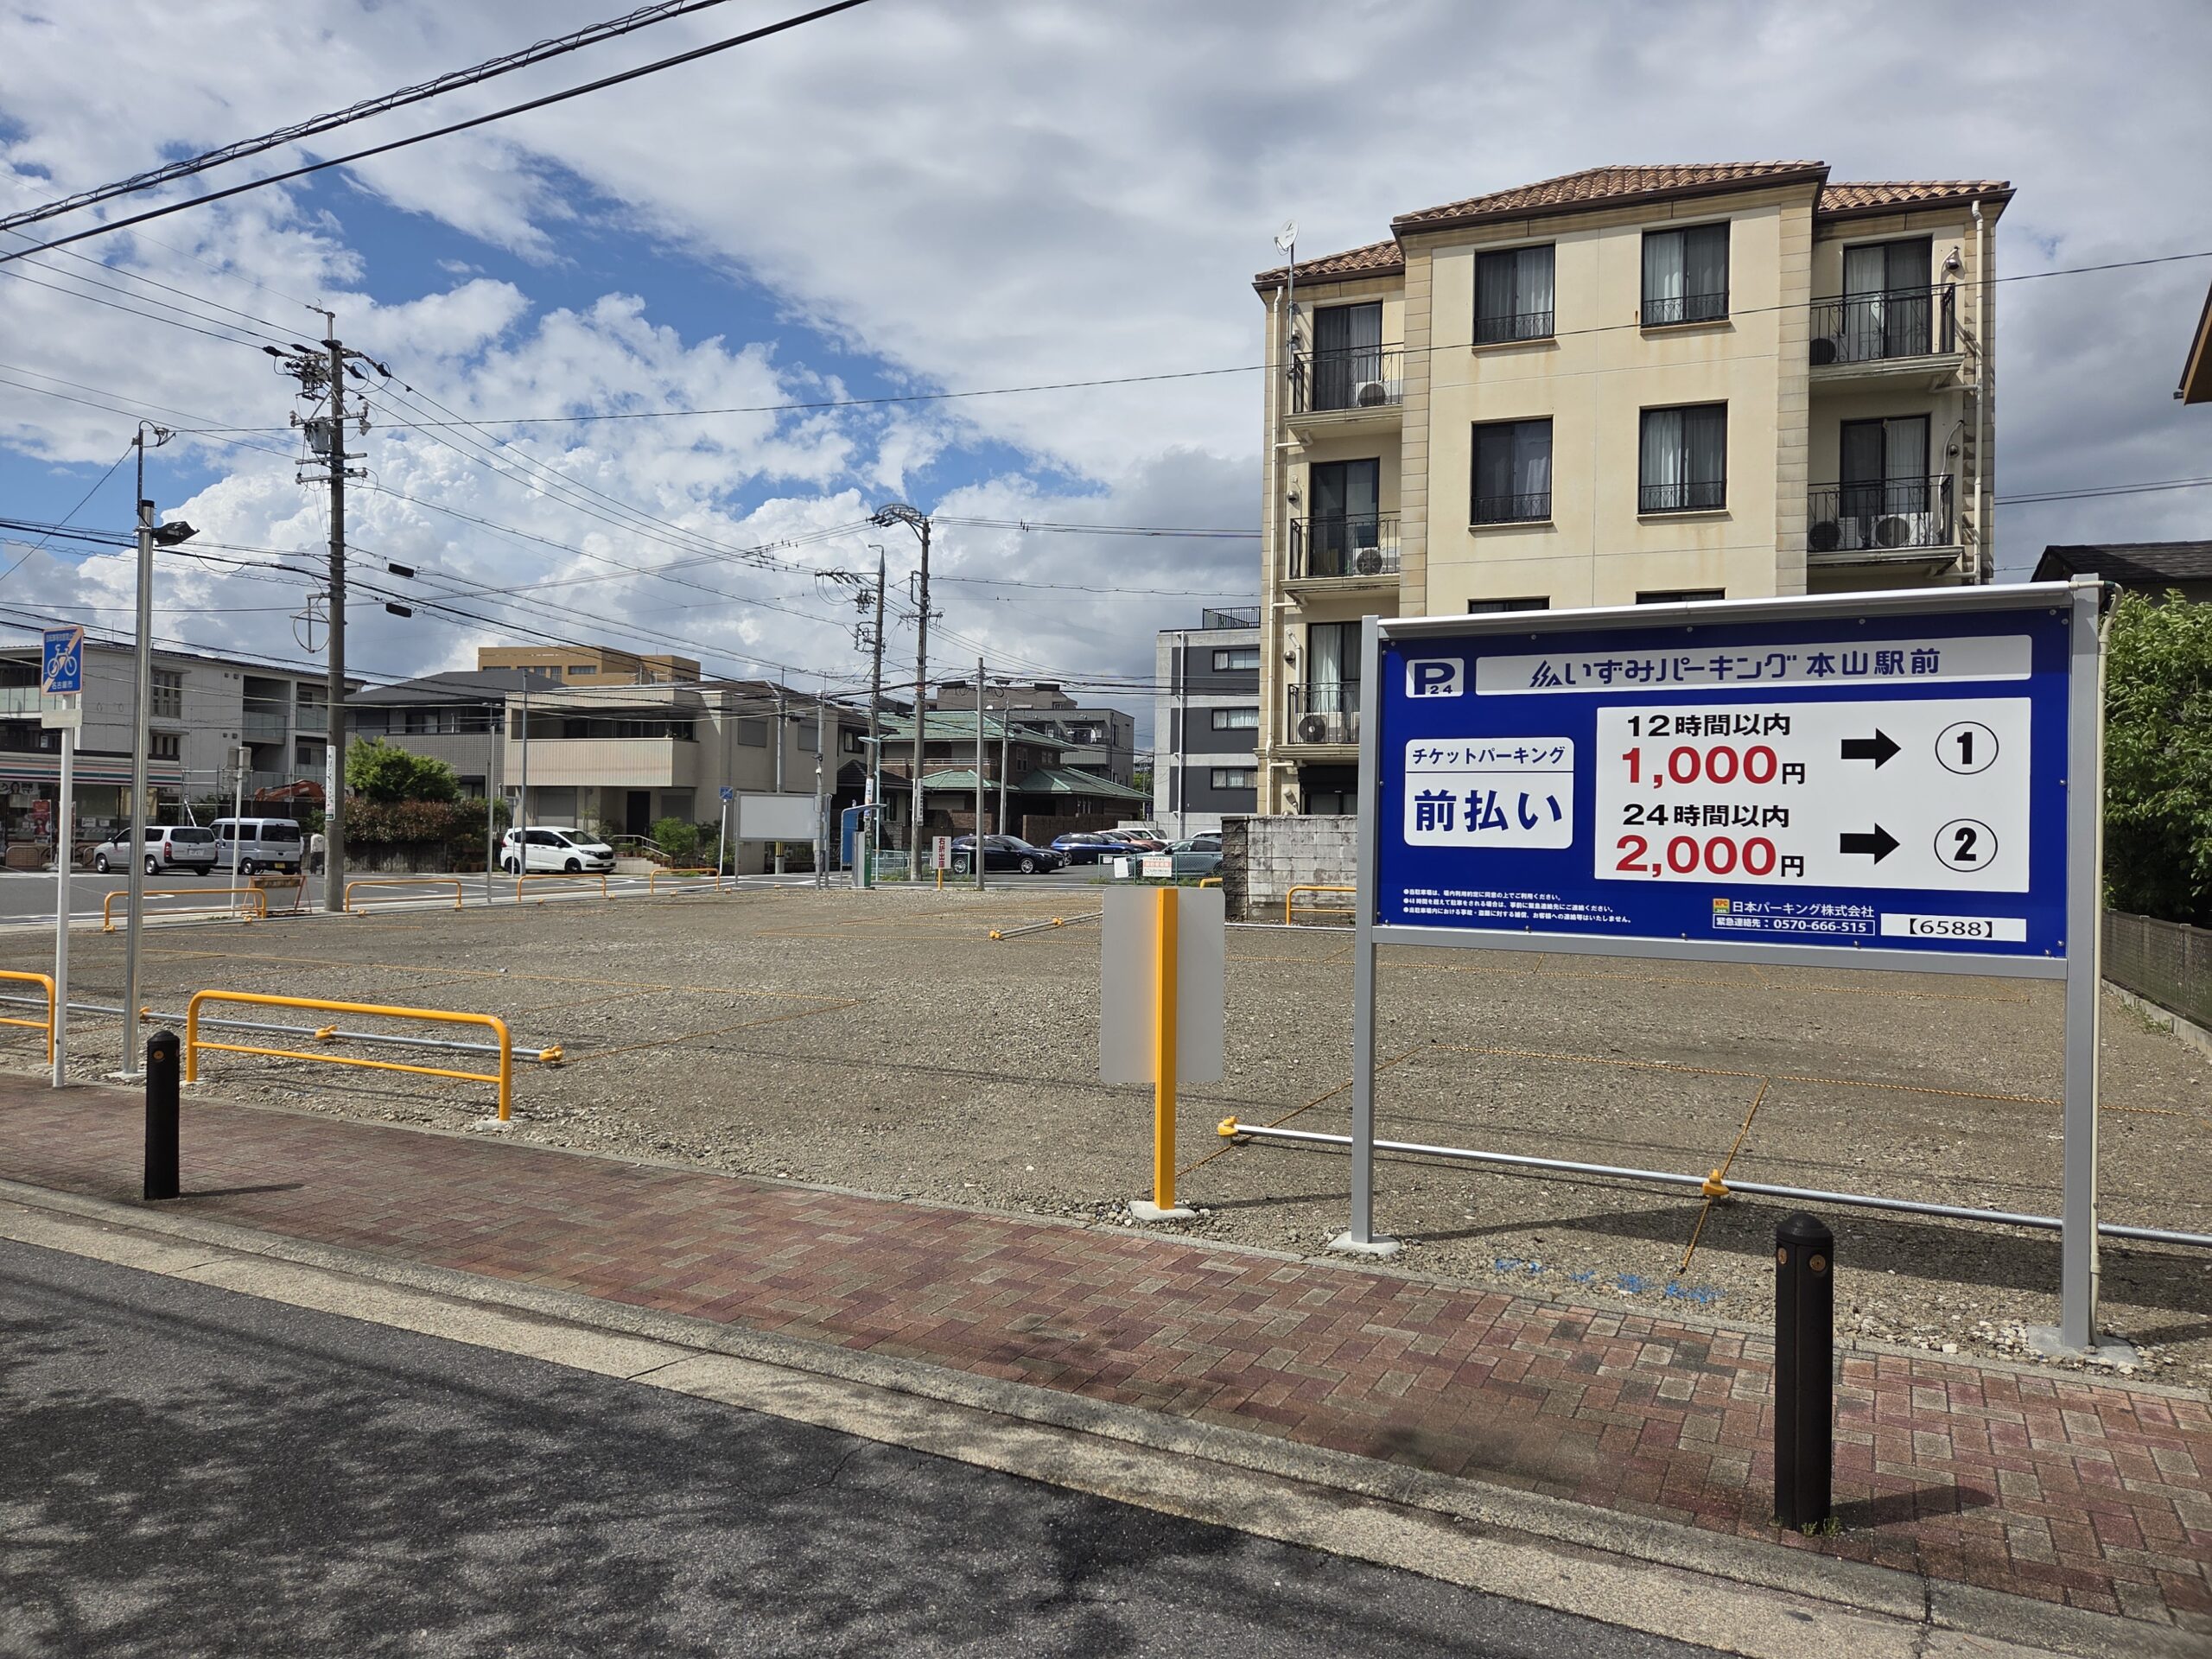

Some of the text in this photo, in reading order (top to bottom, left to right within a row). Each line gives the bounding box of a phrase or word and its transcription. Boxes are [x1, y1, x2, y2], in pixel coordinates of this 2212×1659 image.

[1565, 647, 1941, 684] いずみパーキング 本山駅前
[1414, 662, 1456, 695] P
[1430, 684, 1453, 695] 24
[1627, 713, 1790, 737] 12時間以内
[1412, 746, 1566, 765] チケットパーキング
[1414, 789, 1563, 833] 前払い
[1623, 804, 1789, 829] 24時間以内
[1732, 900, 1874, 918] 日本パーキング株式会社
